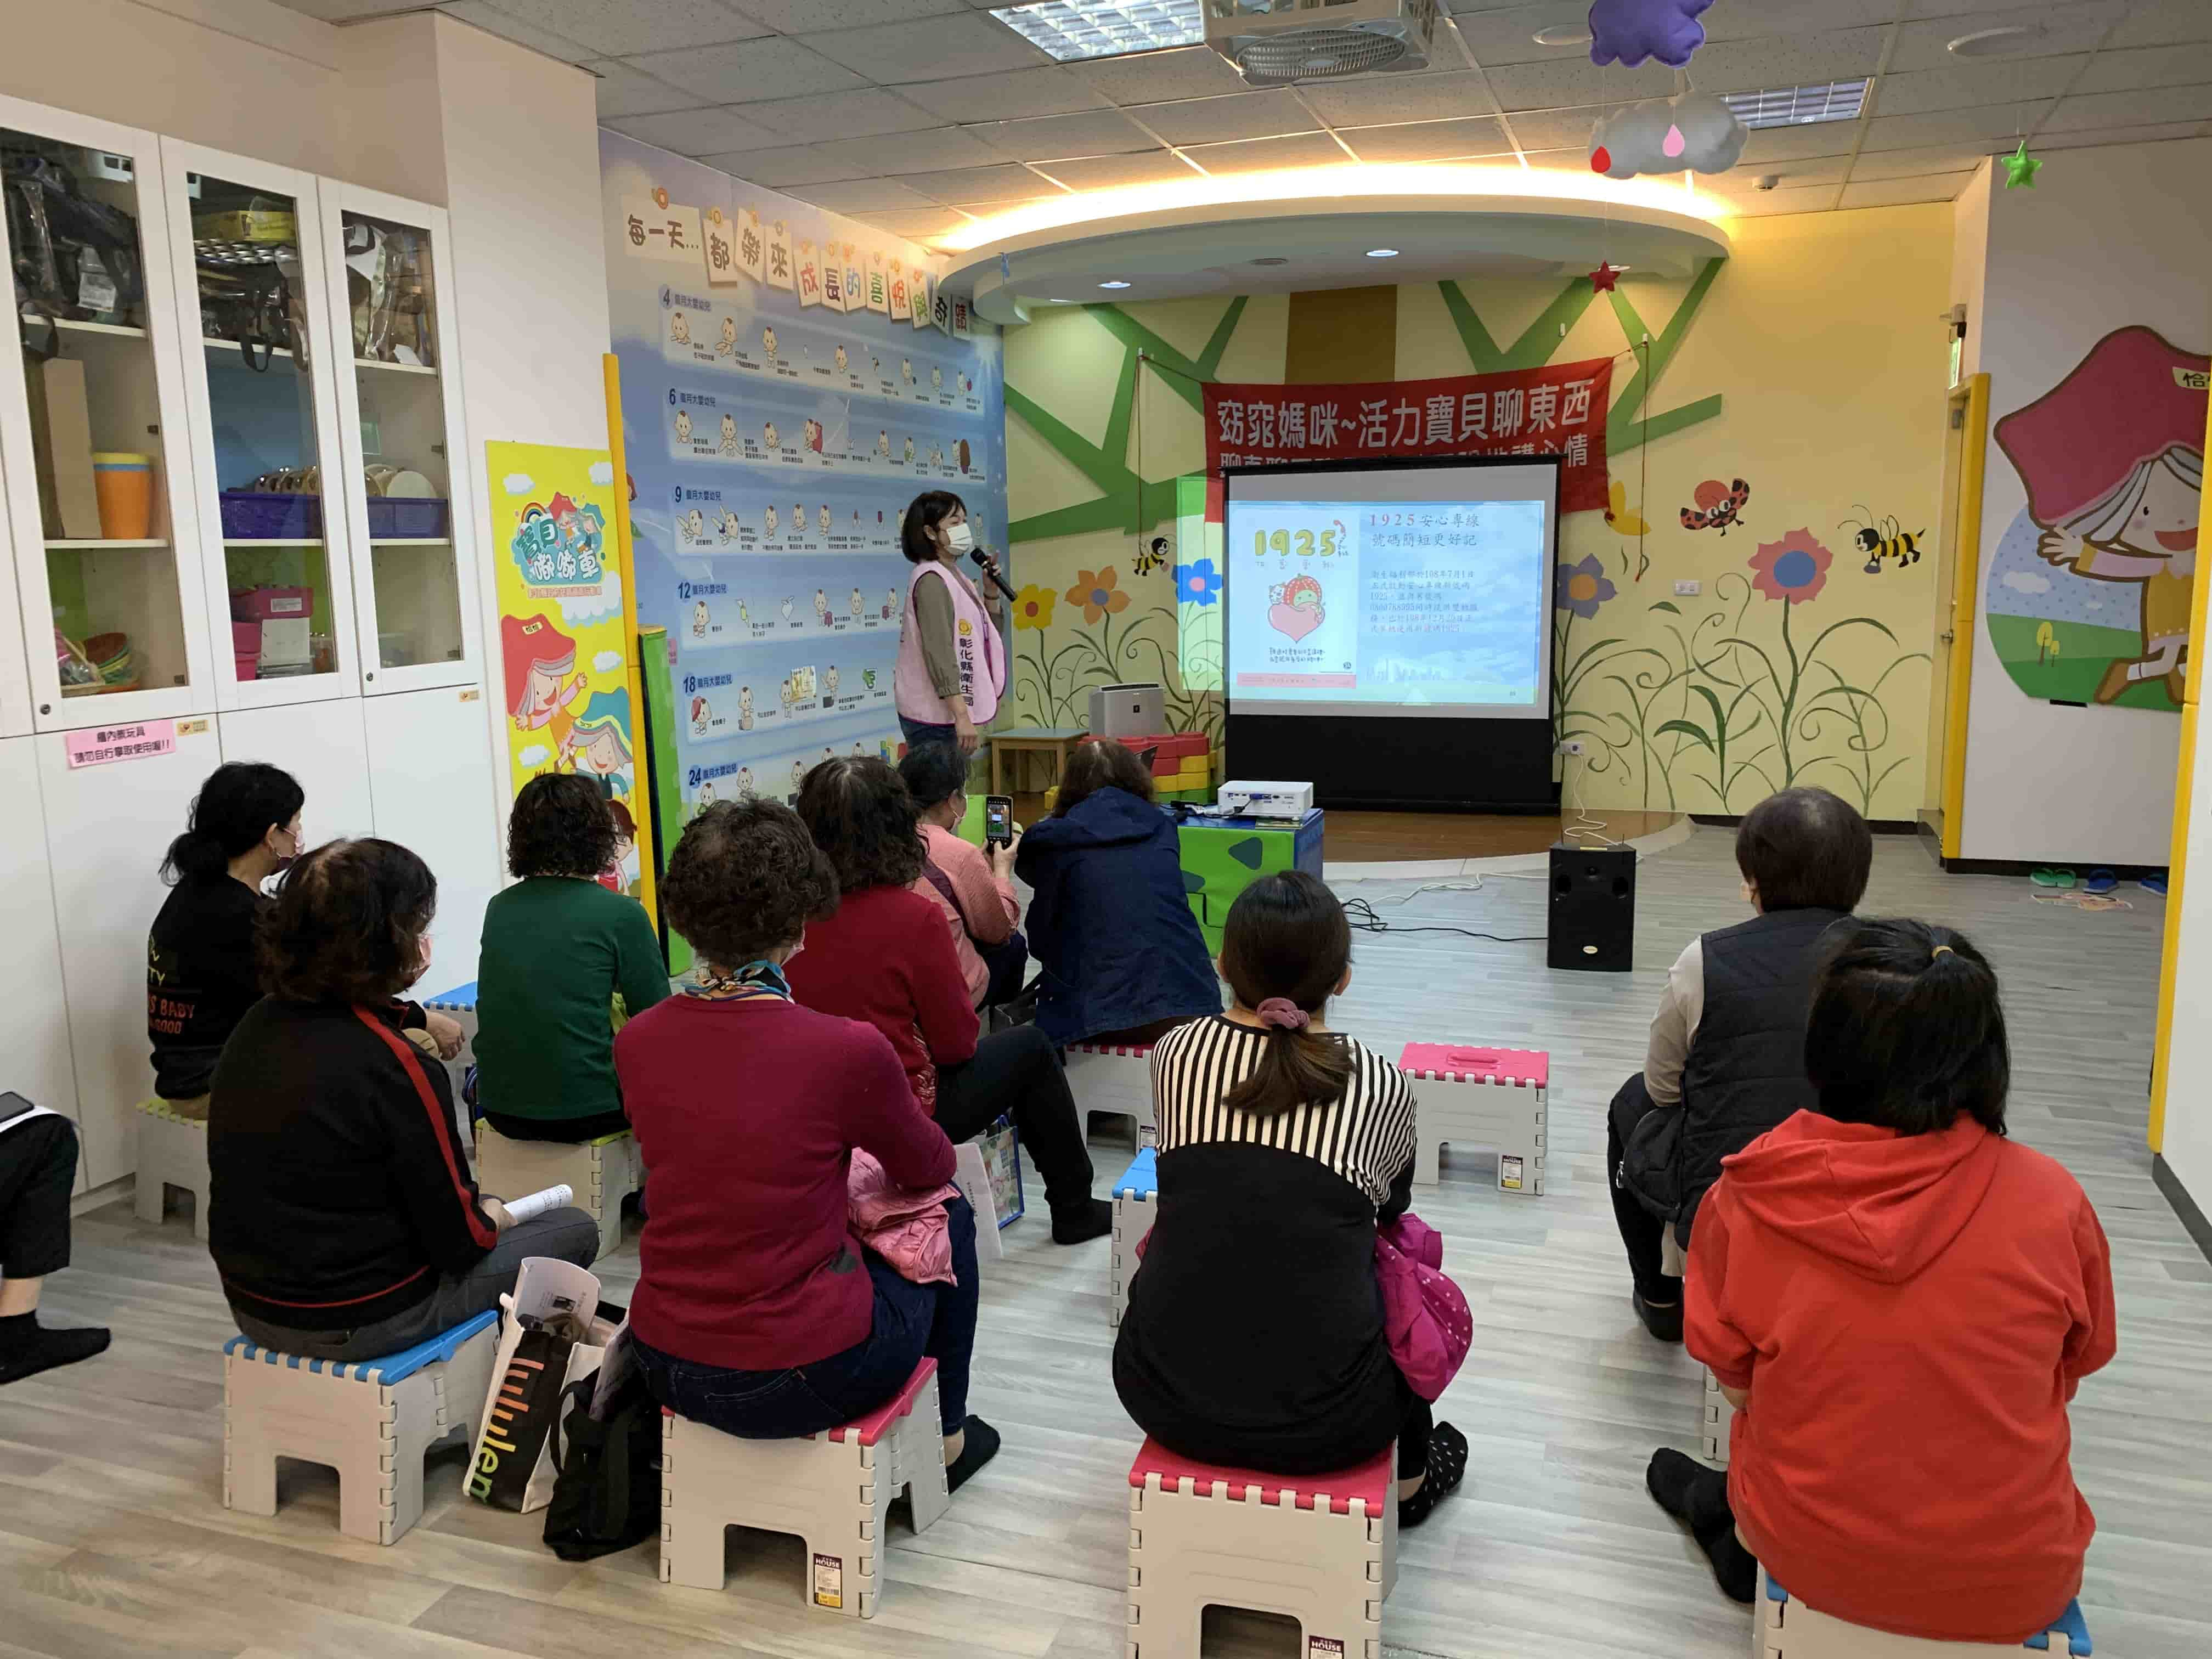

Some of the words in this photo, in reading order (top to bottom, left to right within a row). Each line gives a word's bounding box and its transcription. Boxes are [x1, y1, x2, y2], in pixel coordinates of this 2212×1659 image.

[2183, 373, 2210, 387] 恰
[1254, 528, 1337, 556] 1925
[1372, 532, 1477, 548] 號碼簡短更好記
[816, 1558, 840, 1568] HOUSE
[1311, 1641, 1341, 1652] HOUSE
